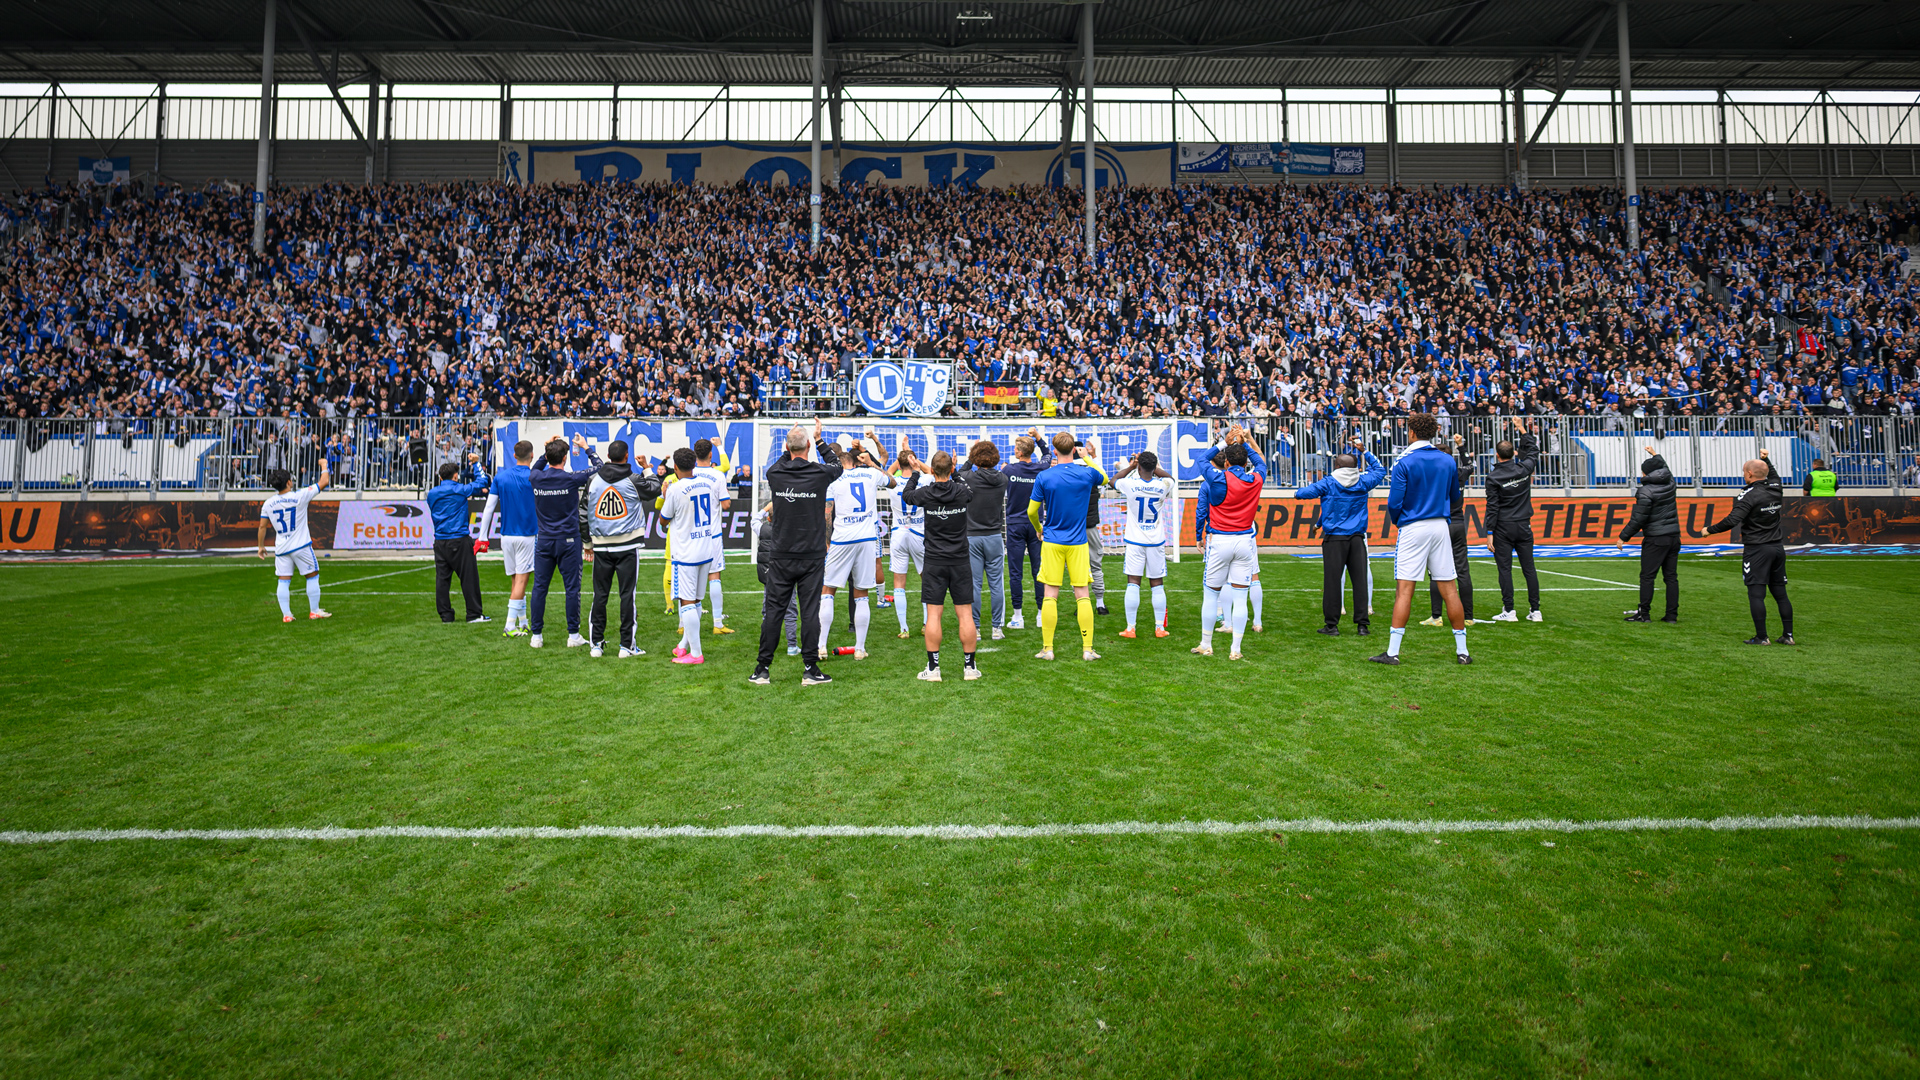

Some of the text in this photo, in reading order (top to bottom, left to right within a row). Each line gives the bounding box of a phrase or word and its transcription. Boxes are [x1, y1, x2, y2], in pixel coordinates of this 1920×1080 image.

[1333, 147, 1364, 159] Fanclub
[903, 386, 945, 414] MAGDEBURG
[538, 488, 569, 496] Humanas
[849, 482, 867, 513] 9
[272, 506, 297, 534] 37
[690, 493, 711, 528] 19
[1135, 496, 1160, 524] 15
[1540, 504, 1716, 538] TIEFU
[353, 520, 423, 539] Fetahu
